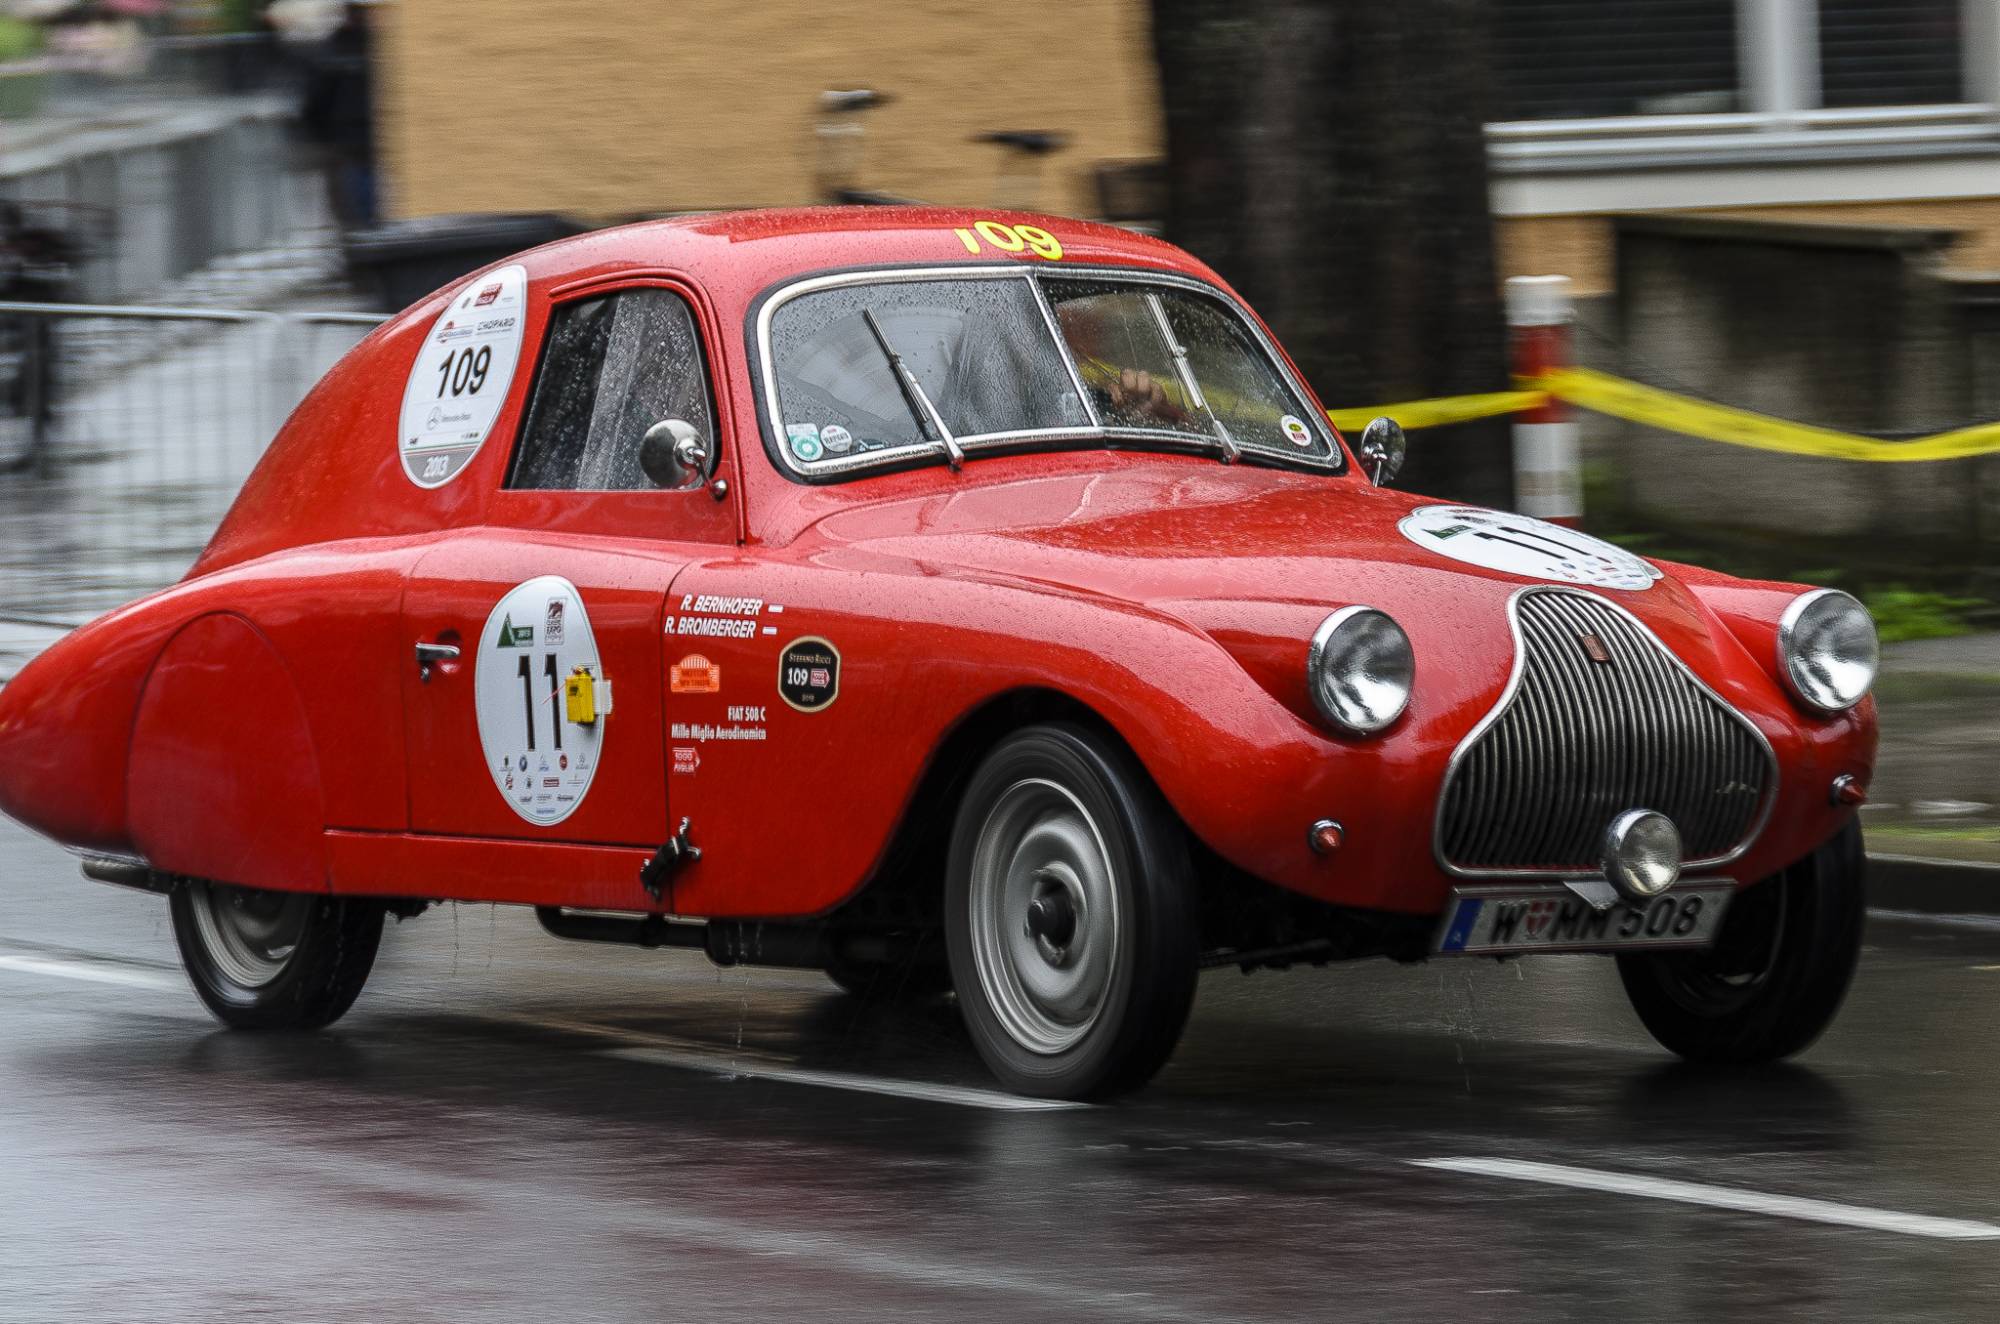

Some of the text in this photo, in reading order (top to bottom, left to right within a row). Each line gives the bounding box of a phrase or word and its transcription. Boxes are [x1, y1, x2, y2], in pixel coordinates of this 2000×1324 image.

[954, 221, 1063, 261] 109
[437, 344, 491, 399] 109
[681, 594, 763, 616] R. BERNHOFER
[664, 616, 757, 638] R. BROMBERGER
[787, 667, 809, 687] 109
[517, 653, 562, 752] 11
[728, 705, 766, 721] FIAT 508 C
[671, 723, 767, 743] Mille Miglia Aerodinamica
[1490, 901, 1529, 943] W
[1617, 894, 1704, 937] 508
